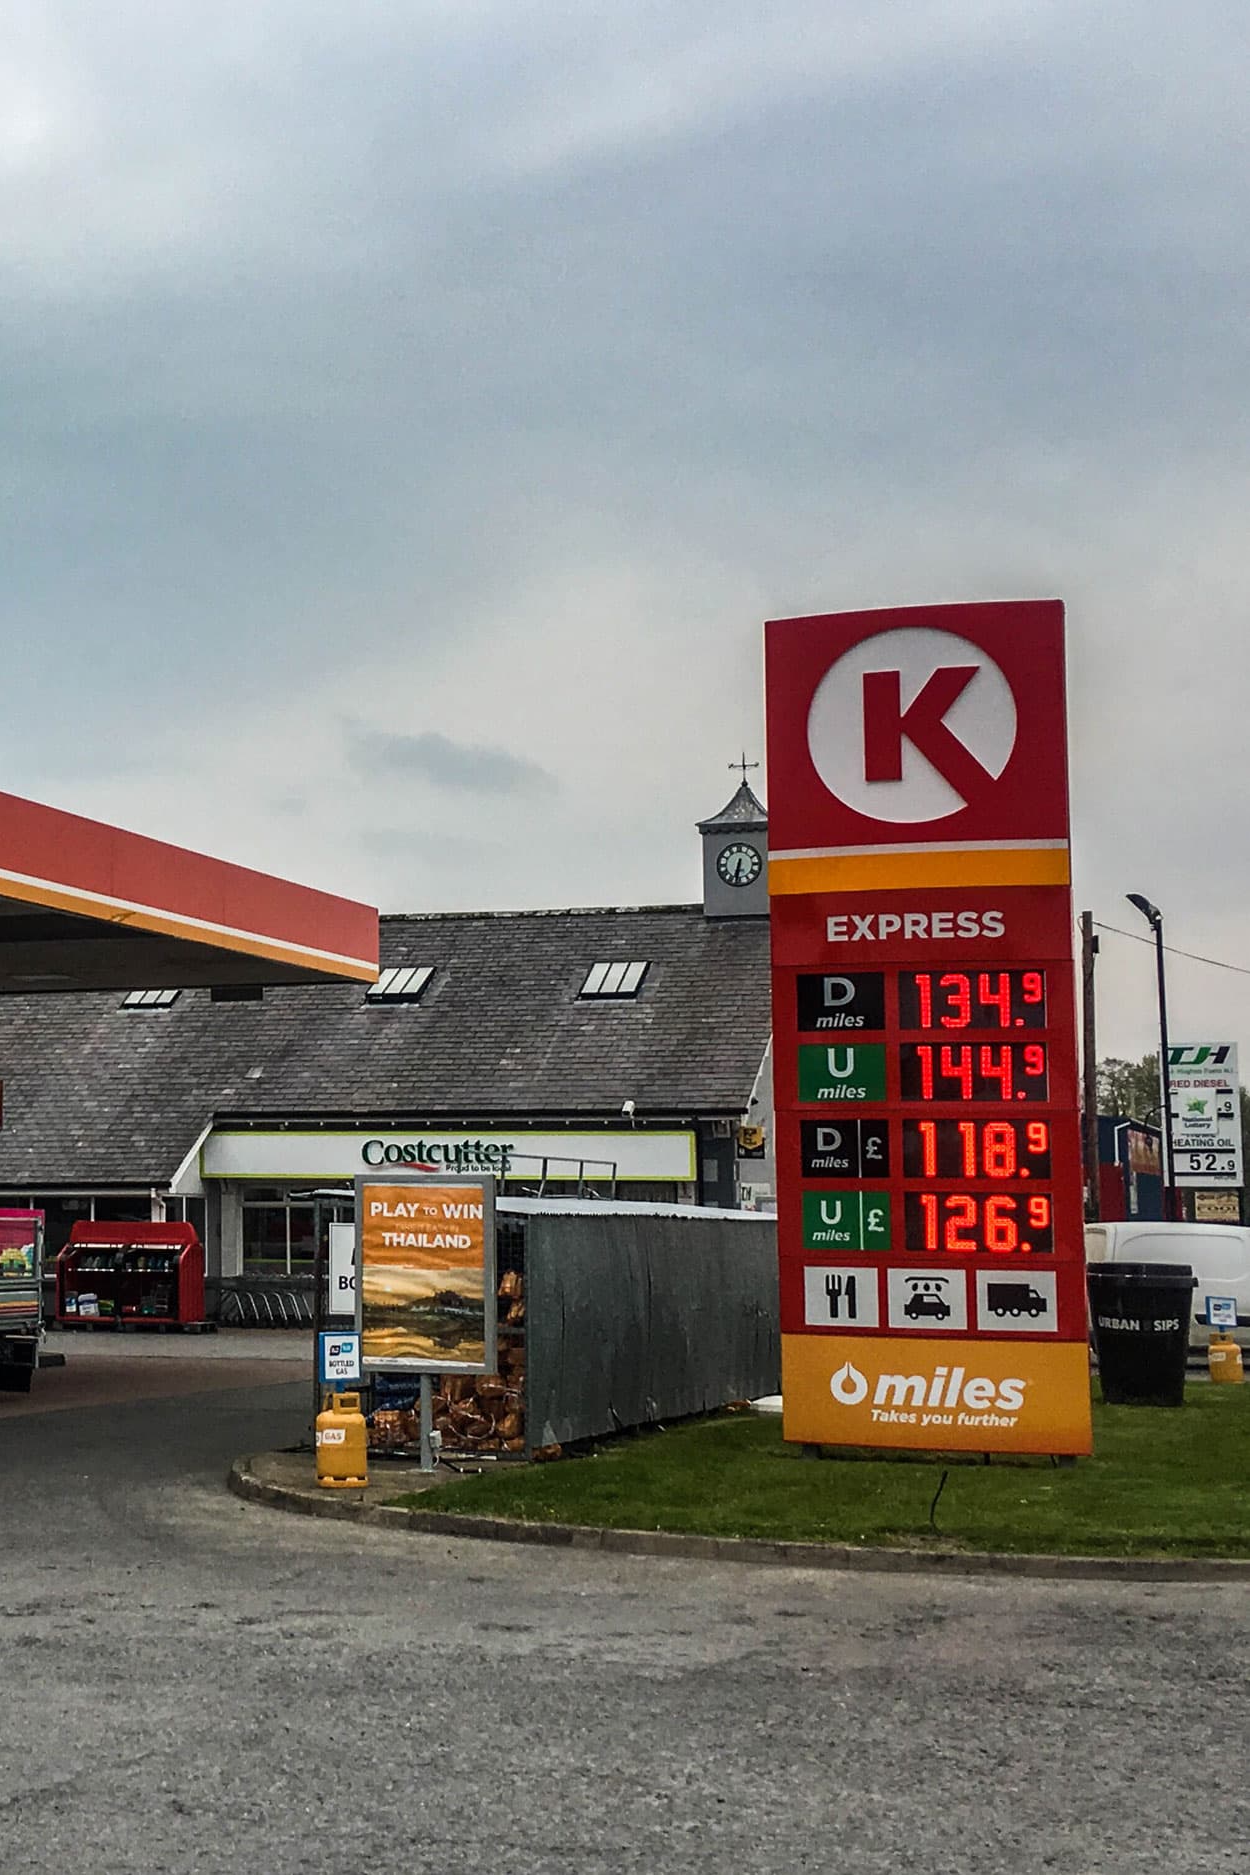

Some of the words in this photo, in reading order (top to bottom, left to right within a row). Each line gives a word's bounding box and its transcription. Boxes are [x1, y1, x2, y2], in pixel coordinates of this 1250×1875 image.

[862, 665, 997, 806] K
[826, 911, 1005, 942] EXPRESS
[824, 977, 856, 1006] D
[816, 1013, 864, 1028] miles
[827, 1048, 854, 1078] U
[817, 1085, 866, 1099] miles
[1170, 1079, 1191, 1088] RED
[1193, 1079, 1230, 1088] DIESEL
[817, 1128, 842, 1151] D
[865, 1137, 883, 1159] £
[1217, 1138, 1235, 1147] OIL
[362, 1139, 514, 1166] Costcutter
[471, 1164, 480, 1172] to
[481, 1164, 491, 1172] be
[811, 1157, 849, 1168] miles
[1190, 1154, 1235, 1172] 52.9
[370, 1202, 420, 1217] PLAY
[423, 1207, 438, 1216] TO
[442, 1203, 484, 1219] WIN
[821, 1200, 842, 1225] U
[867, 1209, 884, 1232] £
[381, 1232, 472, 1249] THAILAND
[812, 1230, 850, 1242] miles
[1099, 1316, 1140, 1331] URBAN
[1154, 1318, 1180, 1331] SIPS
[329, 1360, 355, 1368] BOTTLED
[873, 1366, 1027, 1410] miles
[871, 1408, 916, 1423] Takes
[921, 1413, 952, 1426] you
[957, 1411, 1019, 1427] further
[325, 1432, 342, 1441] GAS
